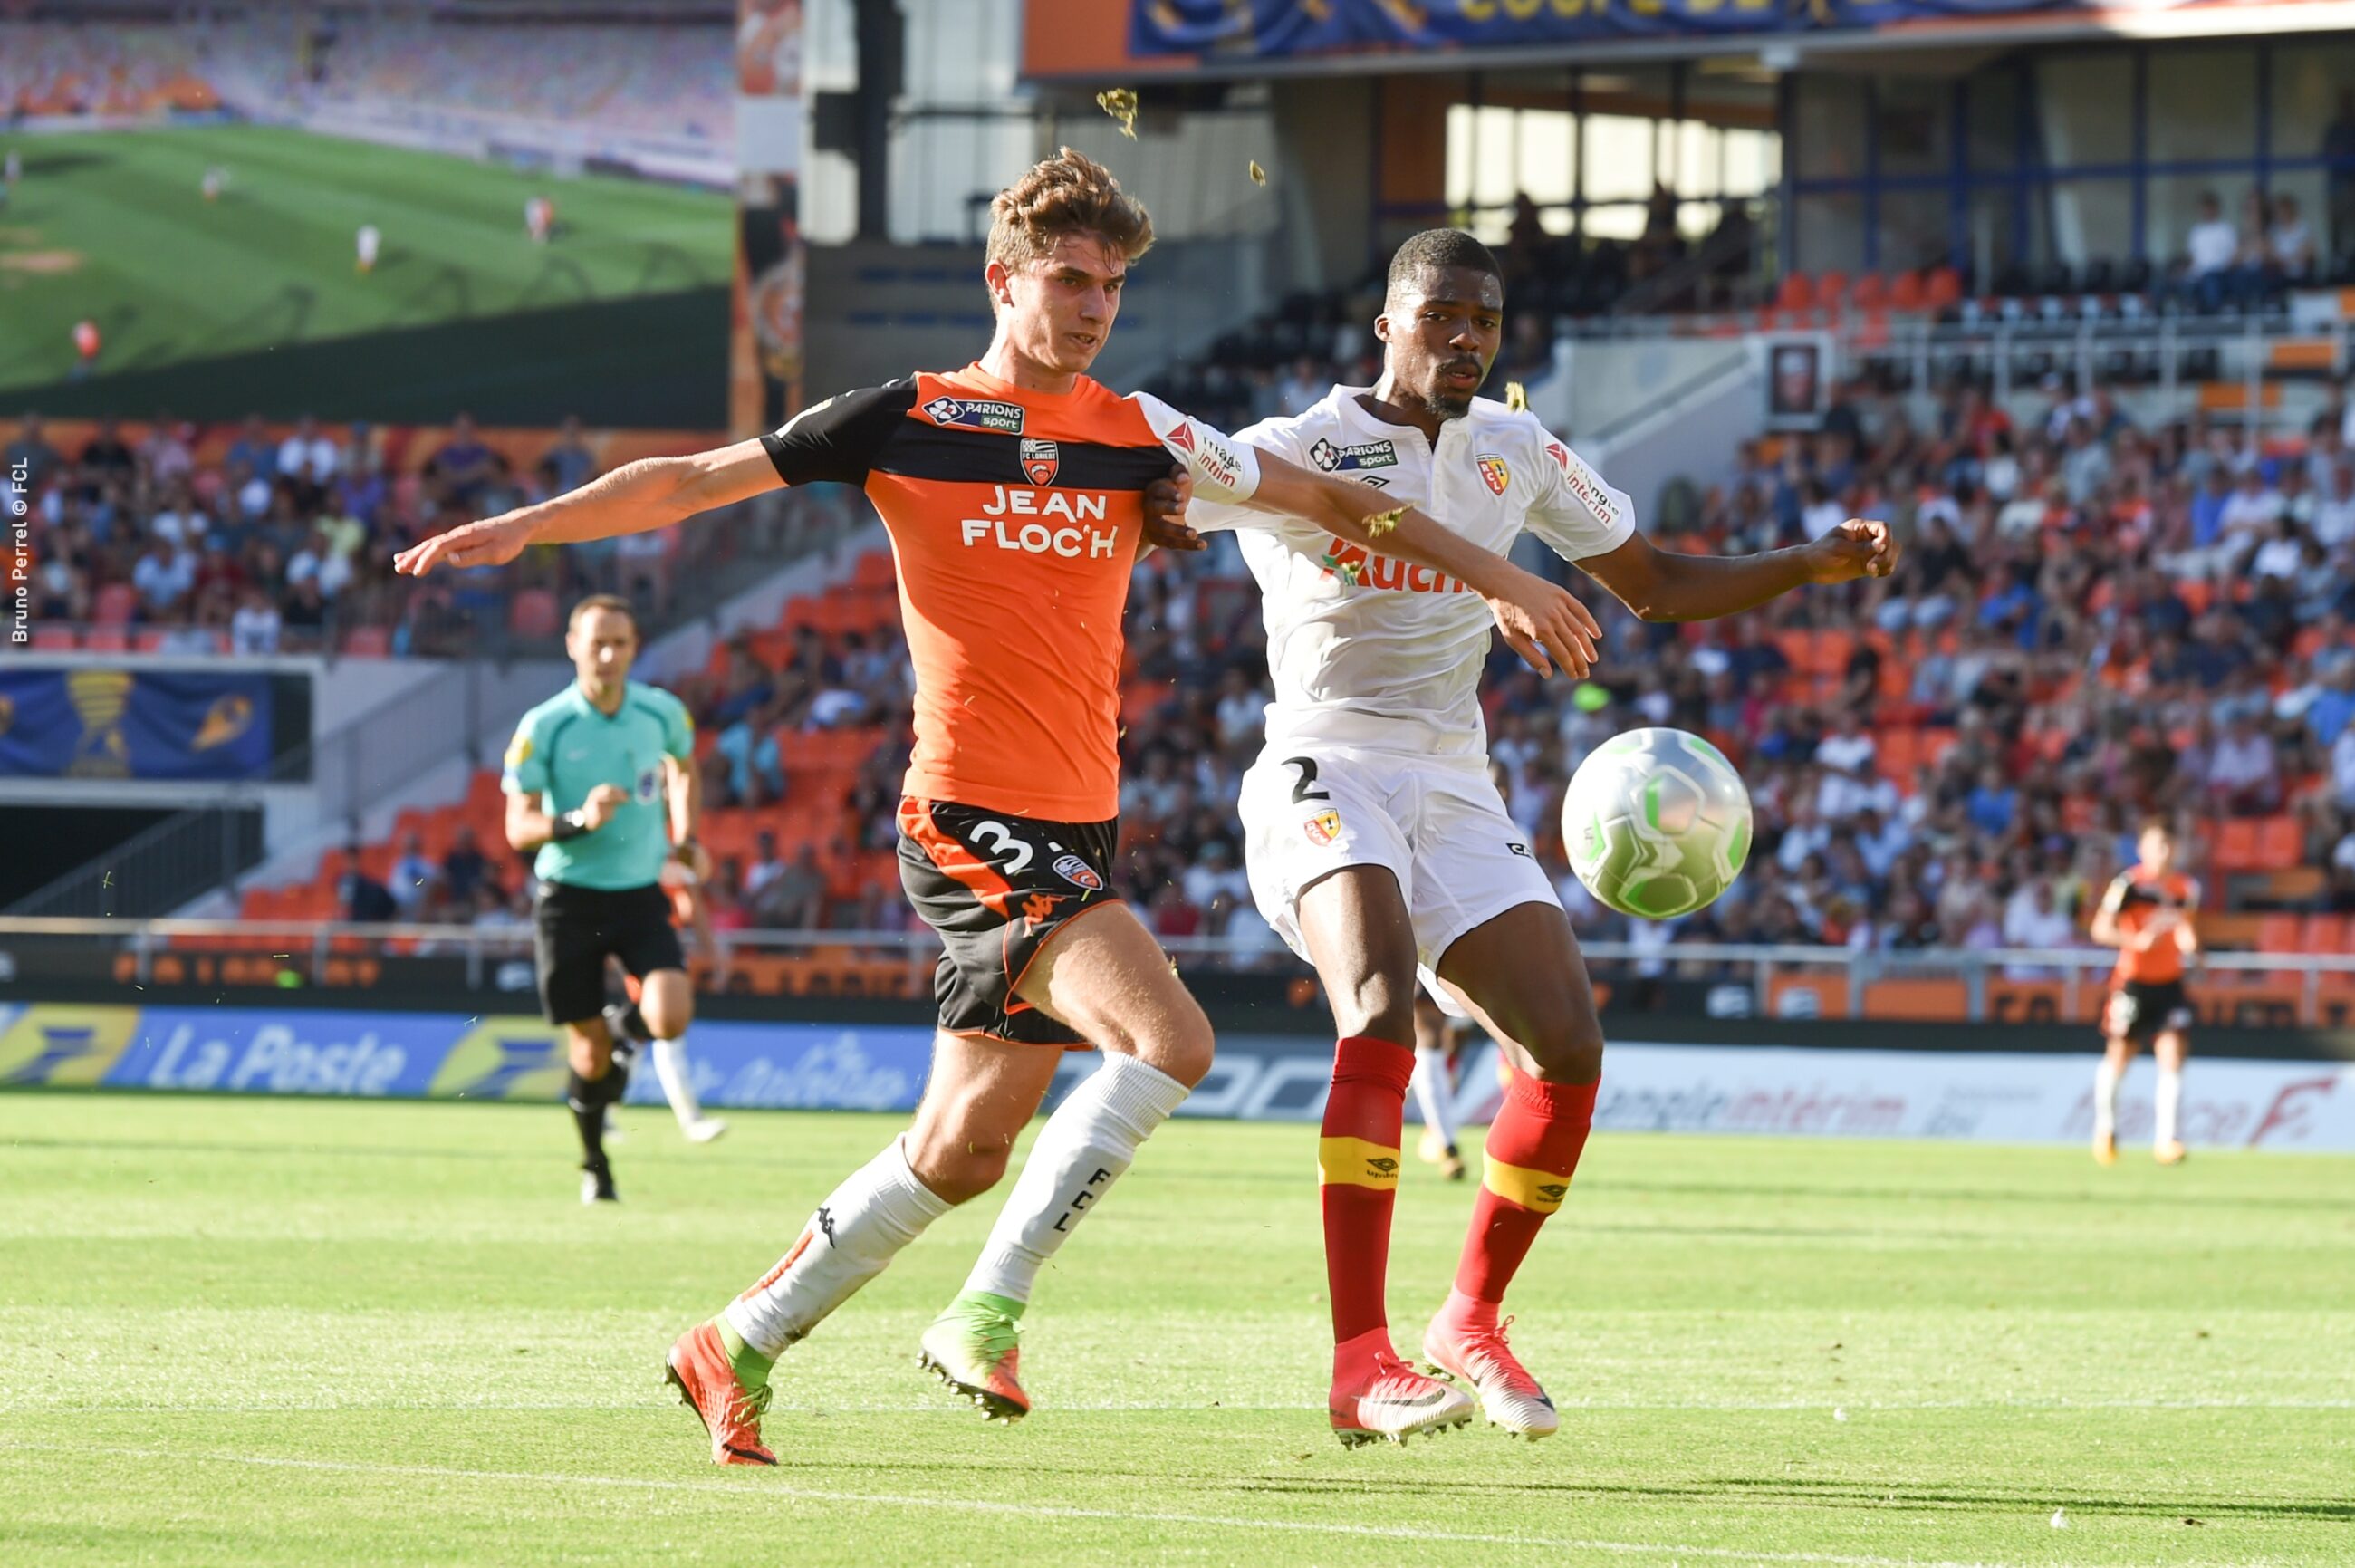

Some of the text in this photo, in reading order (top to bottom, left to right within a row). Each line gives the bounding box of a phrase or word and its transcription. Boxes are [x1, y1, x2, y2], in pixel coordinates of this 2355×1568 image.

[966, 402, 1021, 419] PARIONS
[983, 415, 1017, 429] sport
[1338, 440, 1392, 458] PARIONS
[1359, 453, 1393, 467] sport
[1480, 463, 1501, 491] RCL
[982, 485, 1107, 524] JEAN
[1281, 755, 1330, 804] 2
[149, 1022, 408, 1096] La Poste
